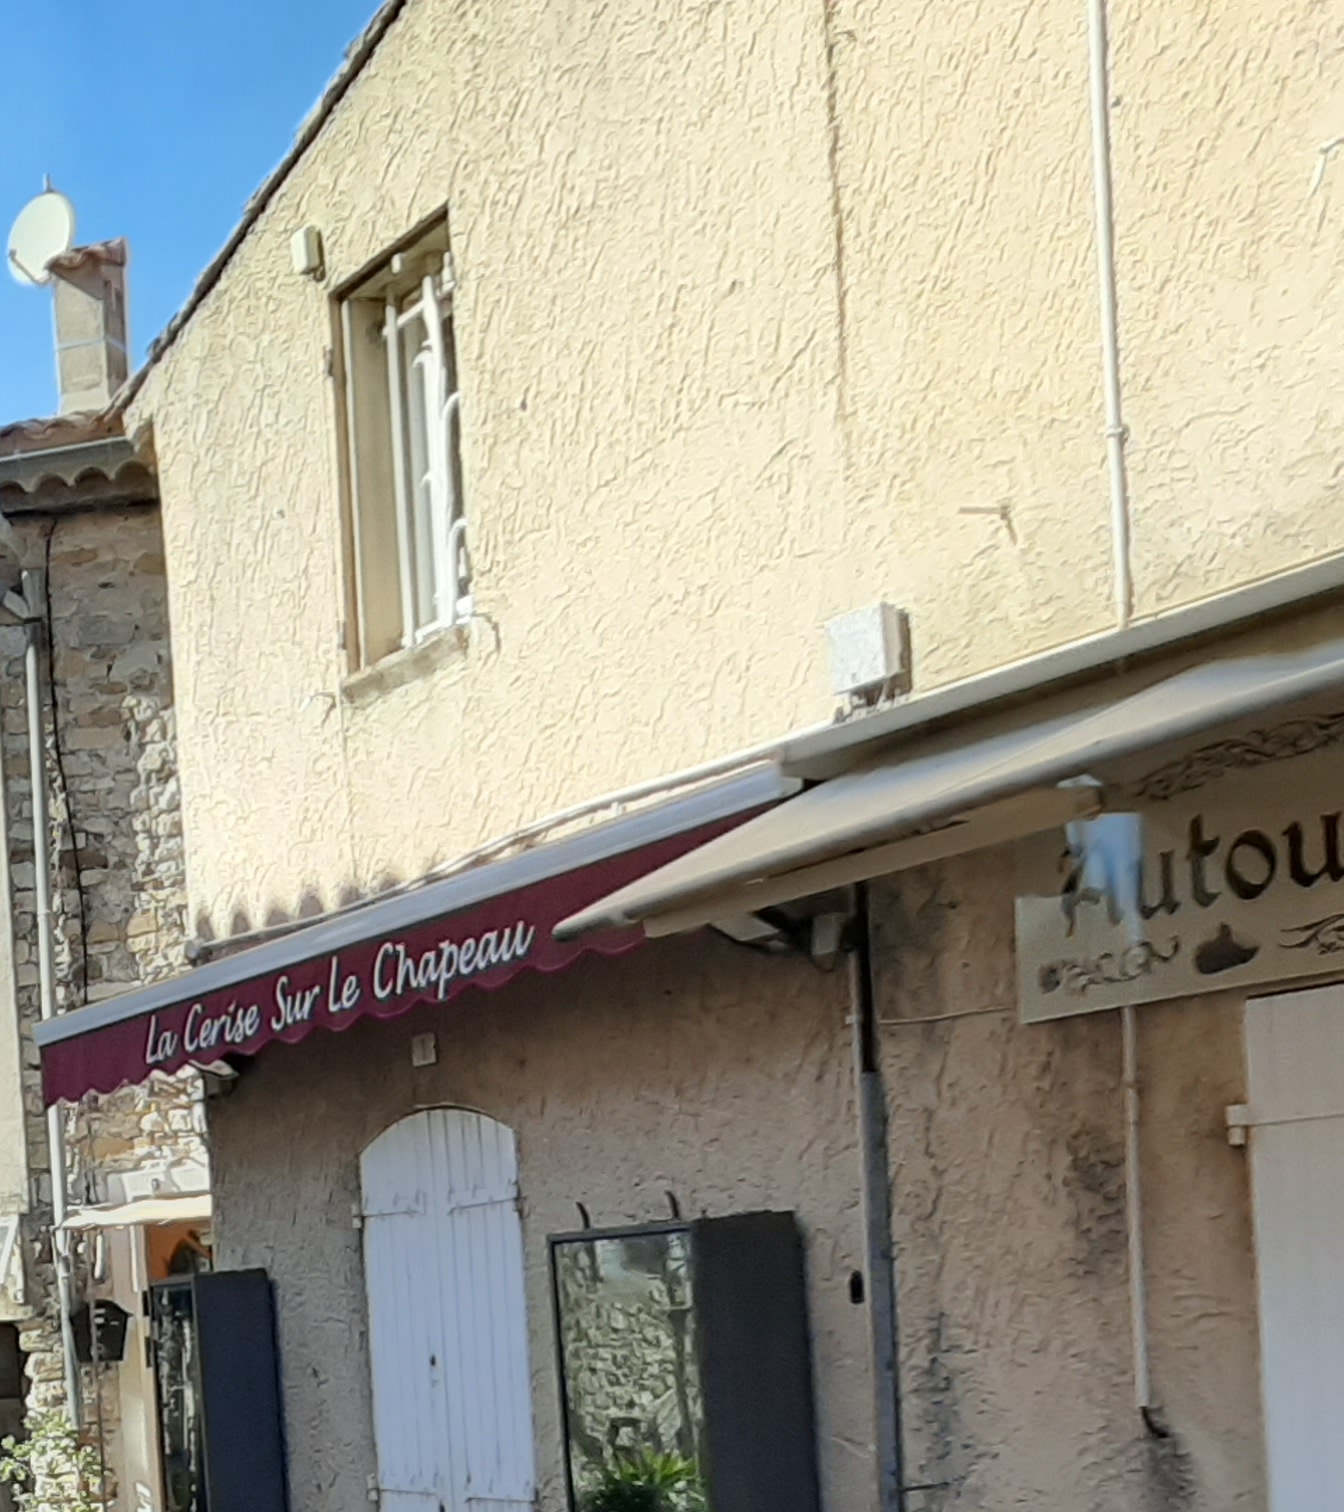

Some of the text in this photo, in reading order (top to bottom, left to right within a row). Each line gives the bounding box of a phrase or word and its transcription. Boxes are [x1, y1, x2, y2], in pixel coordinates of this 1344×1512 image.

[144, 920, 535, 1064] La Cerise Sur Le Chapeau
